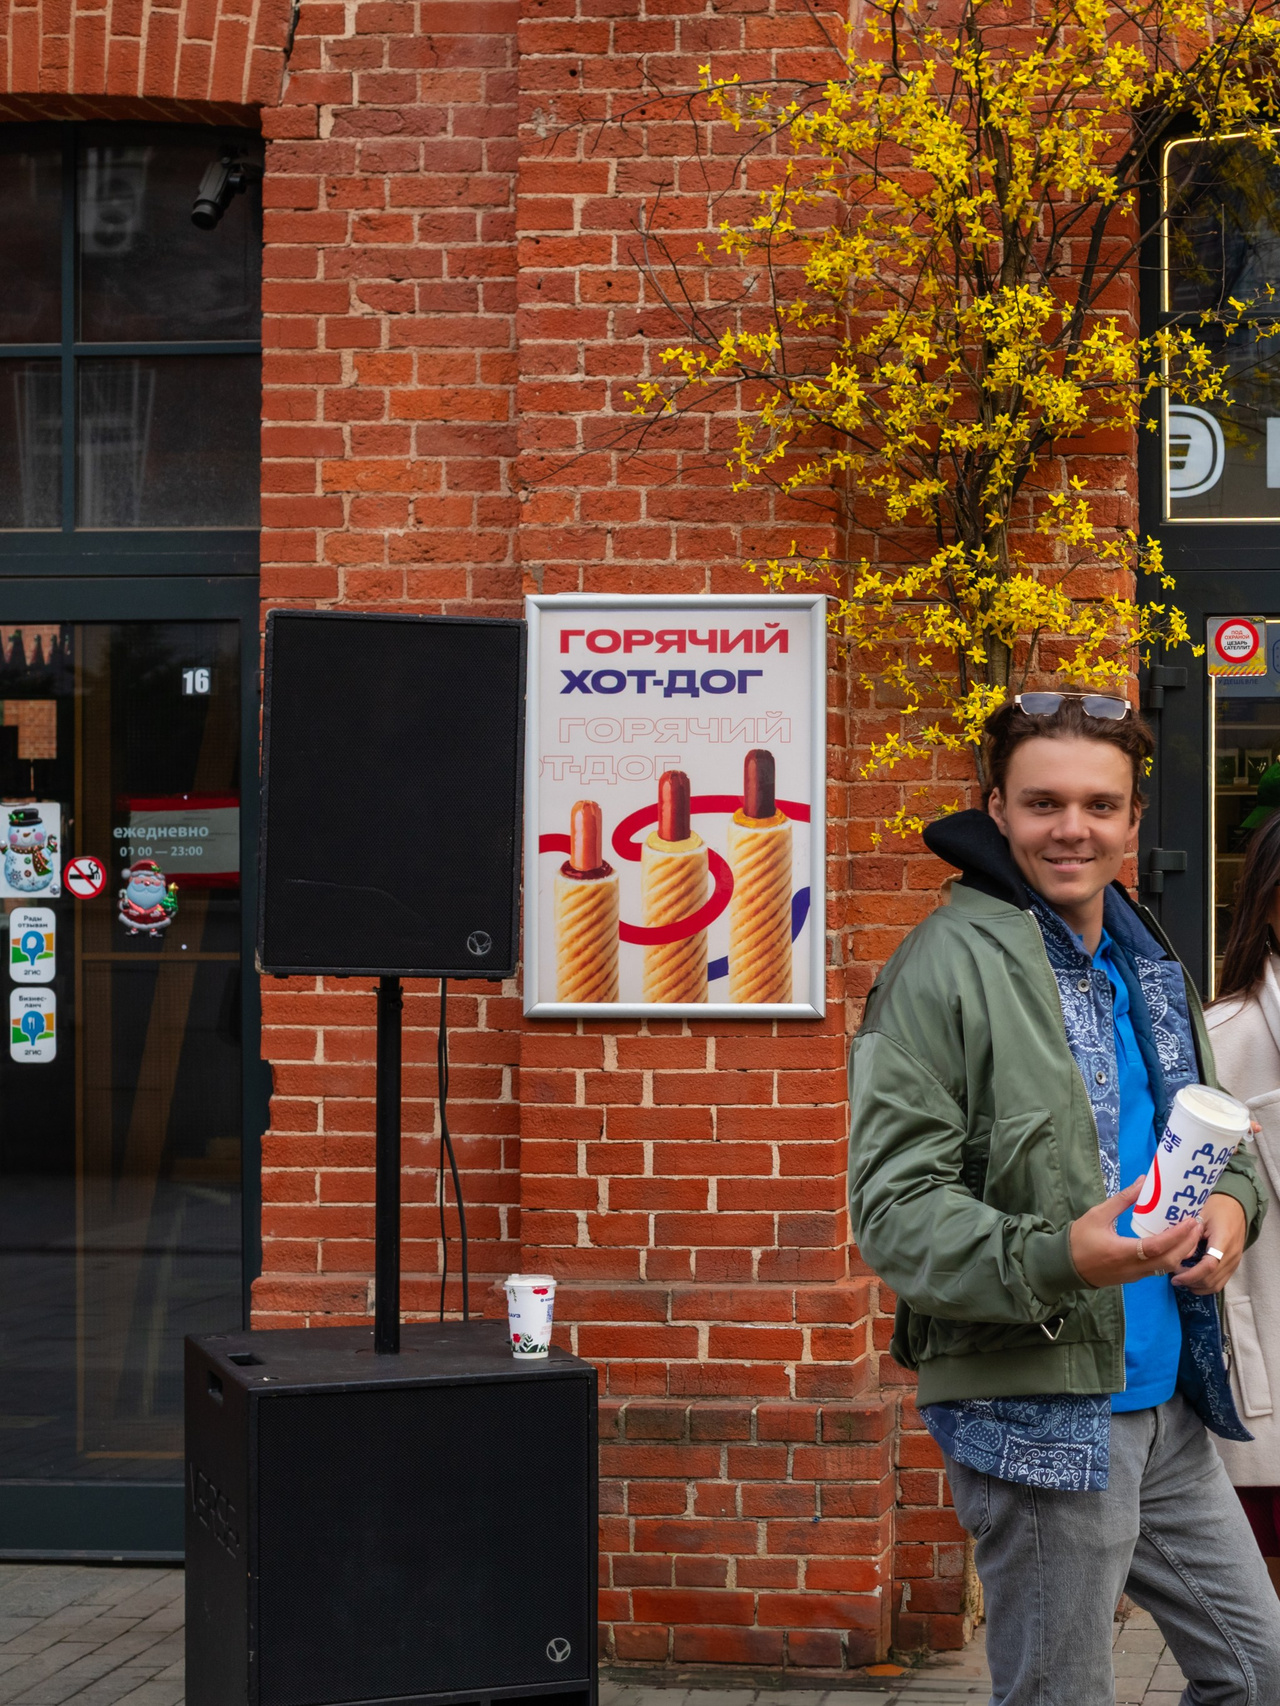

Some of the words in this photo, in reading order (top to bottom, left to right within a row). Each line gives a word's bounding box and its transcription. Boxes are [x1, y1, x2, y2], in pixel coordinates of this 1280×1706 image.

[560, 622, 789, 654] ГОРЯЧИЙ
[182, 669, 210, 694] 16
[560, 669, 763, 698] ХОТ-ДОГ
[558, 711, 792, 744] ГОРЯЧИЙ
[539, 755, 681, 785] Т-ДОГ
[113, 827, 209, 840] ежедневно
[170, 846, 203, 857] 23:00
[23, 915, 43, 923] Рады
